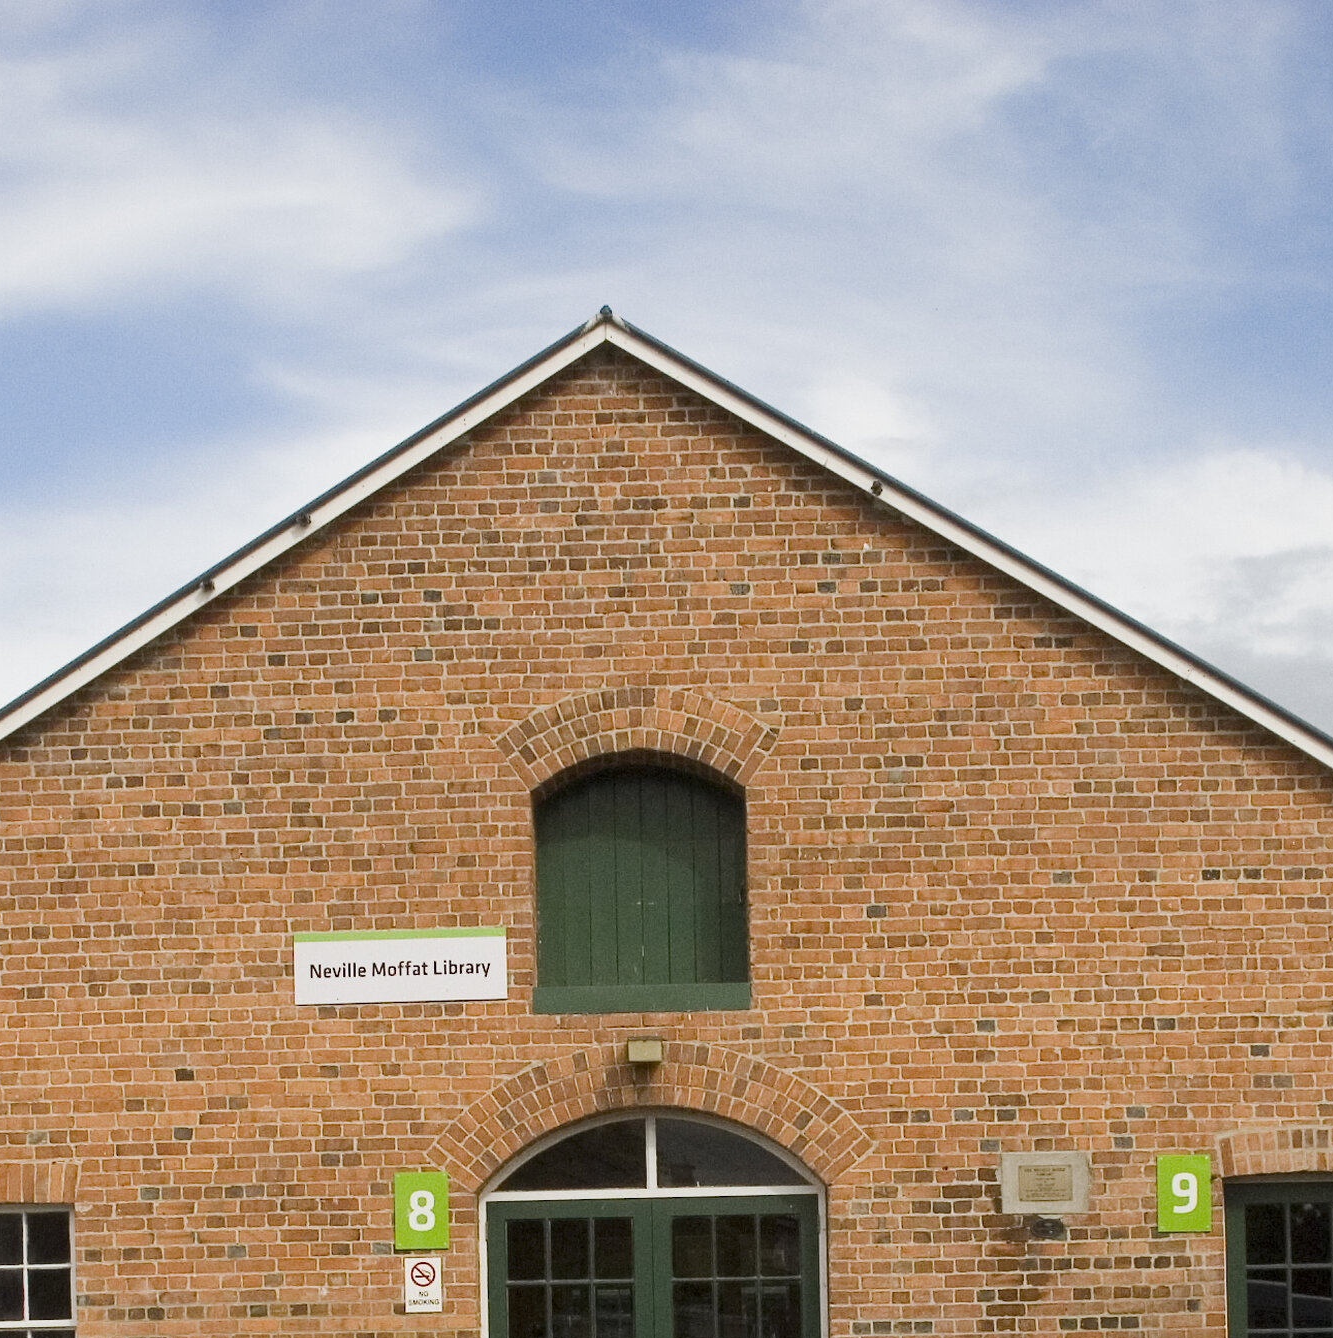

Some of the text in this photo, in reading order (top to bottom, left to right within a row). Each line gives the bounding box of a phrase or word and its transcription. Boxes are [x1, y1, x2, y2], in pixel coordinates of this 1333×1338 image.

[309, 959, 491, 979] Neville Moffat Library
[408, 1190, 436, 1232] 8
[1171, 1172, 1198, 1214] 9
